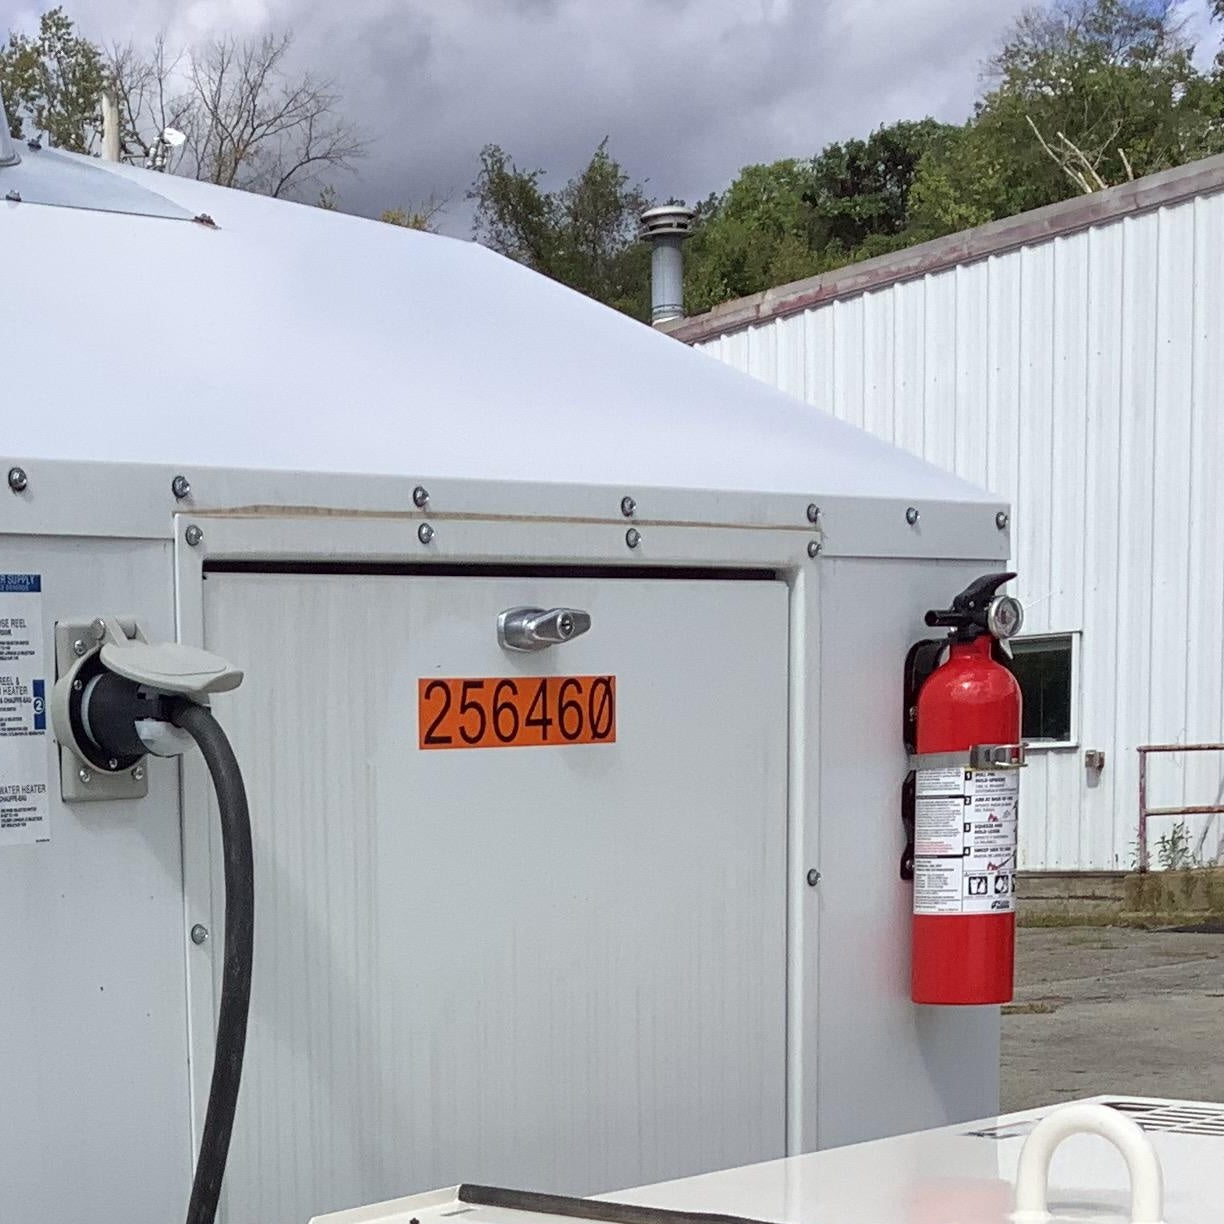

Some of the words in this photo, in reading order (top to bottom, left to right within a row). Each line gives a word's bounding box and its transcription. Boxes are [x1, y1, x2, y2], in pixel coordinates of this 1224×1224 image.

[11, 618, 26, 628] REEL
[16, 676, 20, 686] &
[3, 686, 28, 695] HEATER
[35, 701, 42, 711] 2
[424, 676, 613, 745] 256460
[22, 784, 46, 793] HEATER
